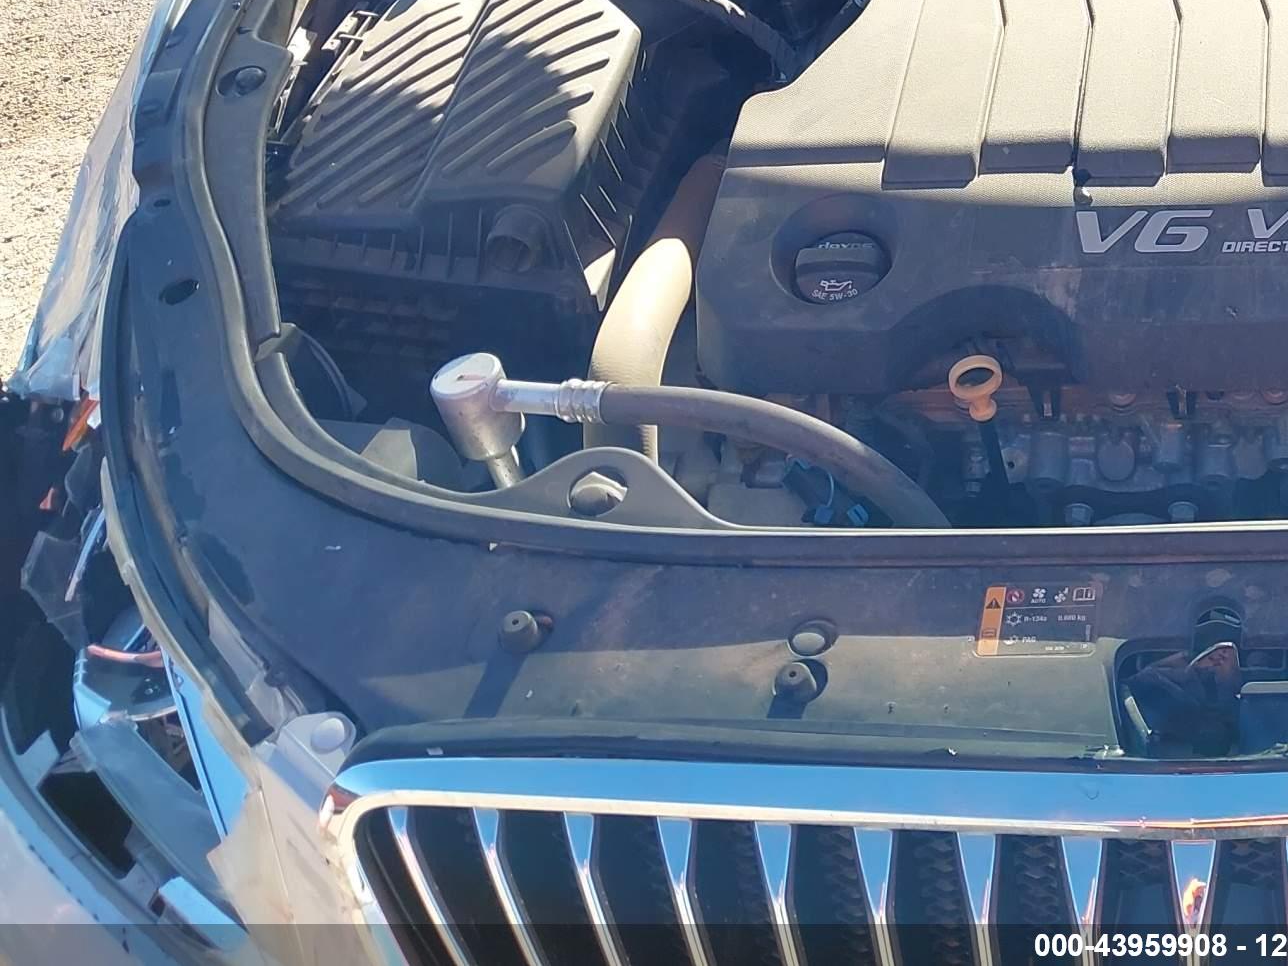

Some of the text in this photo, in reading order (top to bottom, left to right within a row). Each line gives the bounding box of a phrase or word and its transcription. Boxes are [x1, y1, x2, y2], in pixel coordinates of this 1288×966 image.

[1075, 210, 1214, 254] V6
[811, 288, 858, 301] SAE 5W-30
